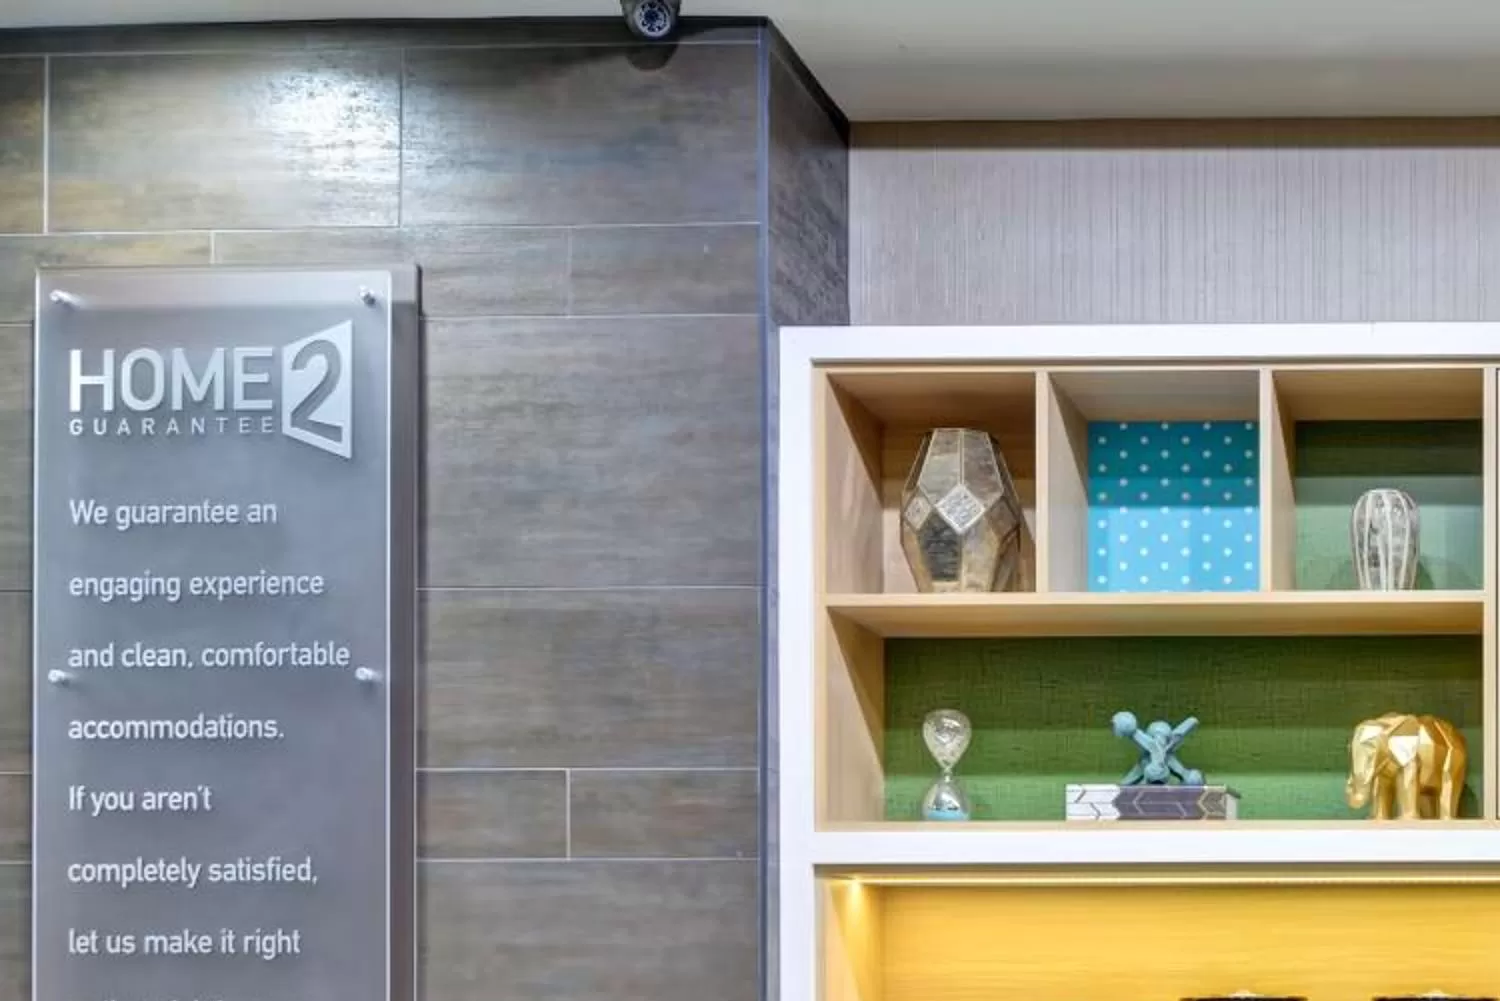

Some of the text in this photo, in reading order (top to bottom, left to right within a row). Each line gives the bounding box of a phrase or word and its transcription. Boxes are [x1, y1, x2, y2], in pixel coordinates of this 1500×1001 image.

[69, 347, 273, 412] HOME
[69, 416, 274, 436] GUARANTEE
[70, 500, 278, 531] We guarantee an
[69, 570, 324, 601] engaging experience
[68, 640, 351, 669] and clean, comfortable
[68, 713, 285, 739] accommodations.
[68, 785, 212, 816] If you aren't
[67, 856, 318, 888] completely satisfied,
[68, 928, 301, 960] let us make it right
